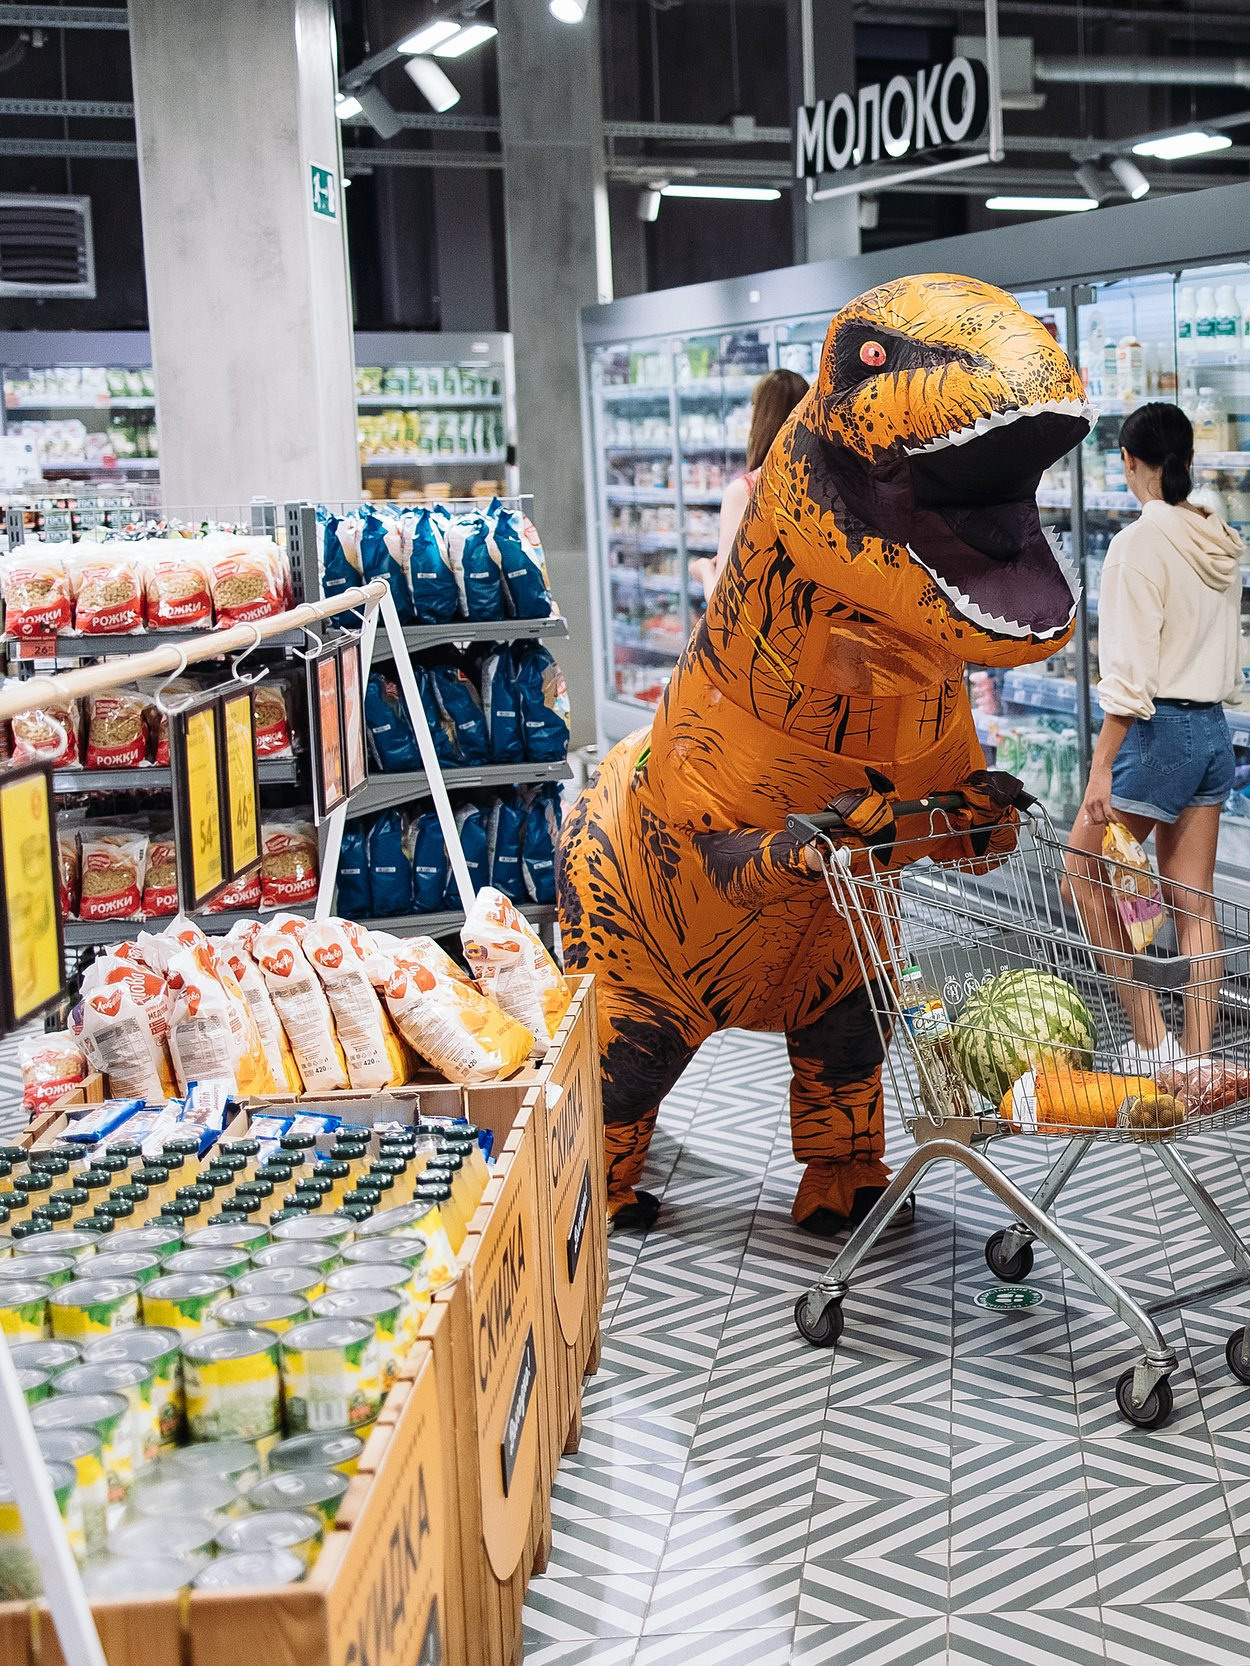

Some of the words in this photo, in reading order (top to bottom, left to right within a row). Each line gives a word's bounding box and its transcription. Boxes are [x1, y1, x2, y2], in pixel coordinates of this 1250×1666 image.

[797, 56, 978, 178] МОЛОКО
[161, 601, 202, 617] ОЖКИ
[34, 645, 48, 655] 26
[96, 748, 139, 766] РОЖКИ
[237, 795, 249, 830] 46
[200, 815, 213, 854] 54
[278, 878, 317, 894] РОЖКИ
[90, 896, 133, 915] РОЖКИ
[551, 1068, 584, 1188] СКИДКА
[478, 1214, 526, 1393] СКИДКА
